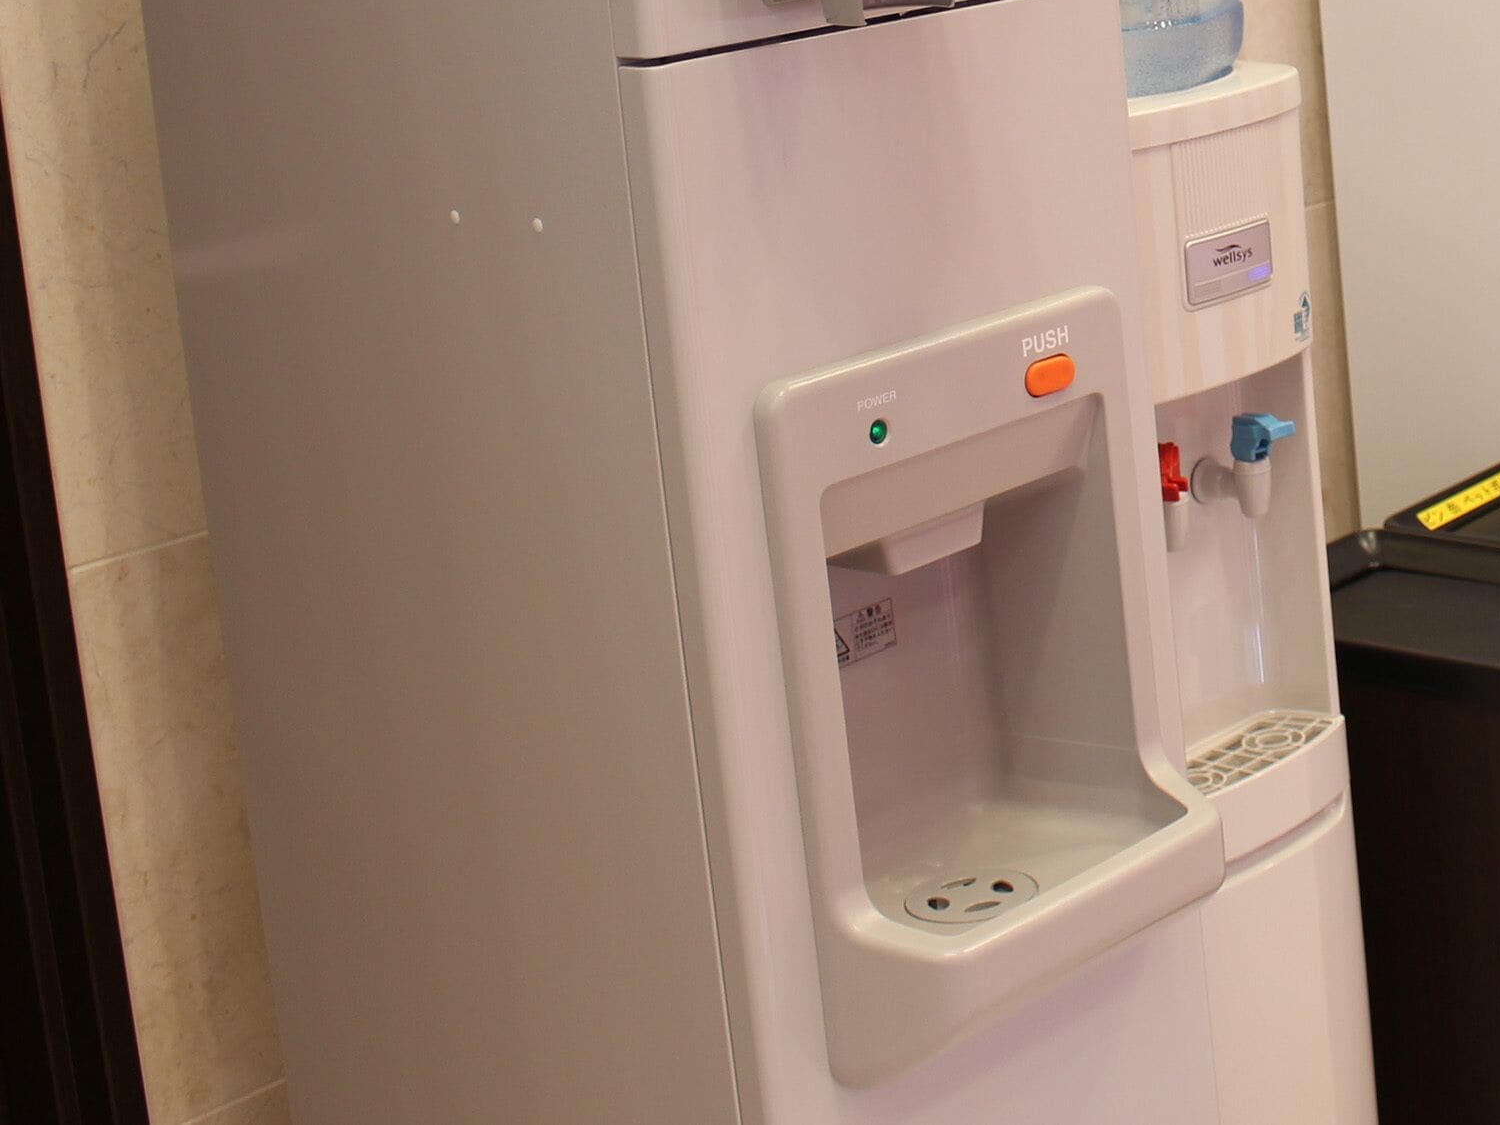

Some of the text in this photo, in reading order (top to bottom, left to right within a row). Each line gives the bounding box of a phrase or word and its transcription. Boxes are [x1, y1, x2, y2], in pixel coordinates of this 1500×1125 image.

[1212, 247, 1253, 267] wellsys
[1021, 325, 1070, 358] PUSH
[856, 389, 898, 413] POWER
